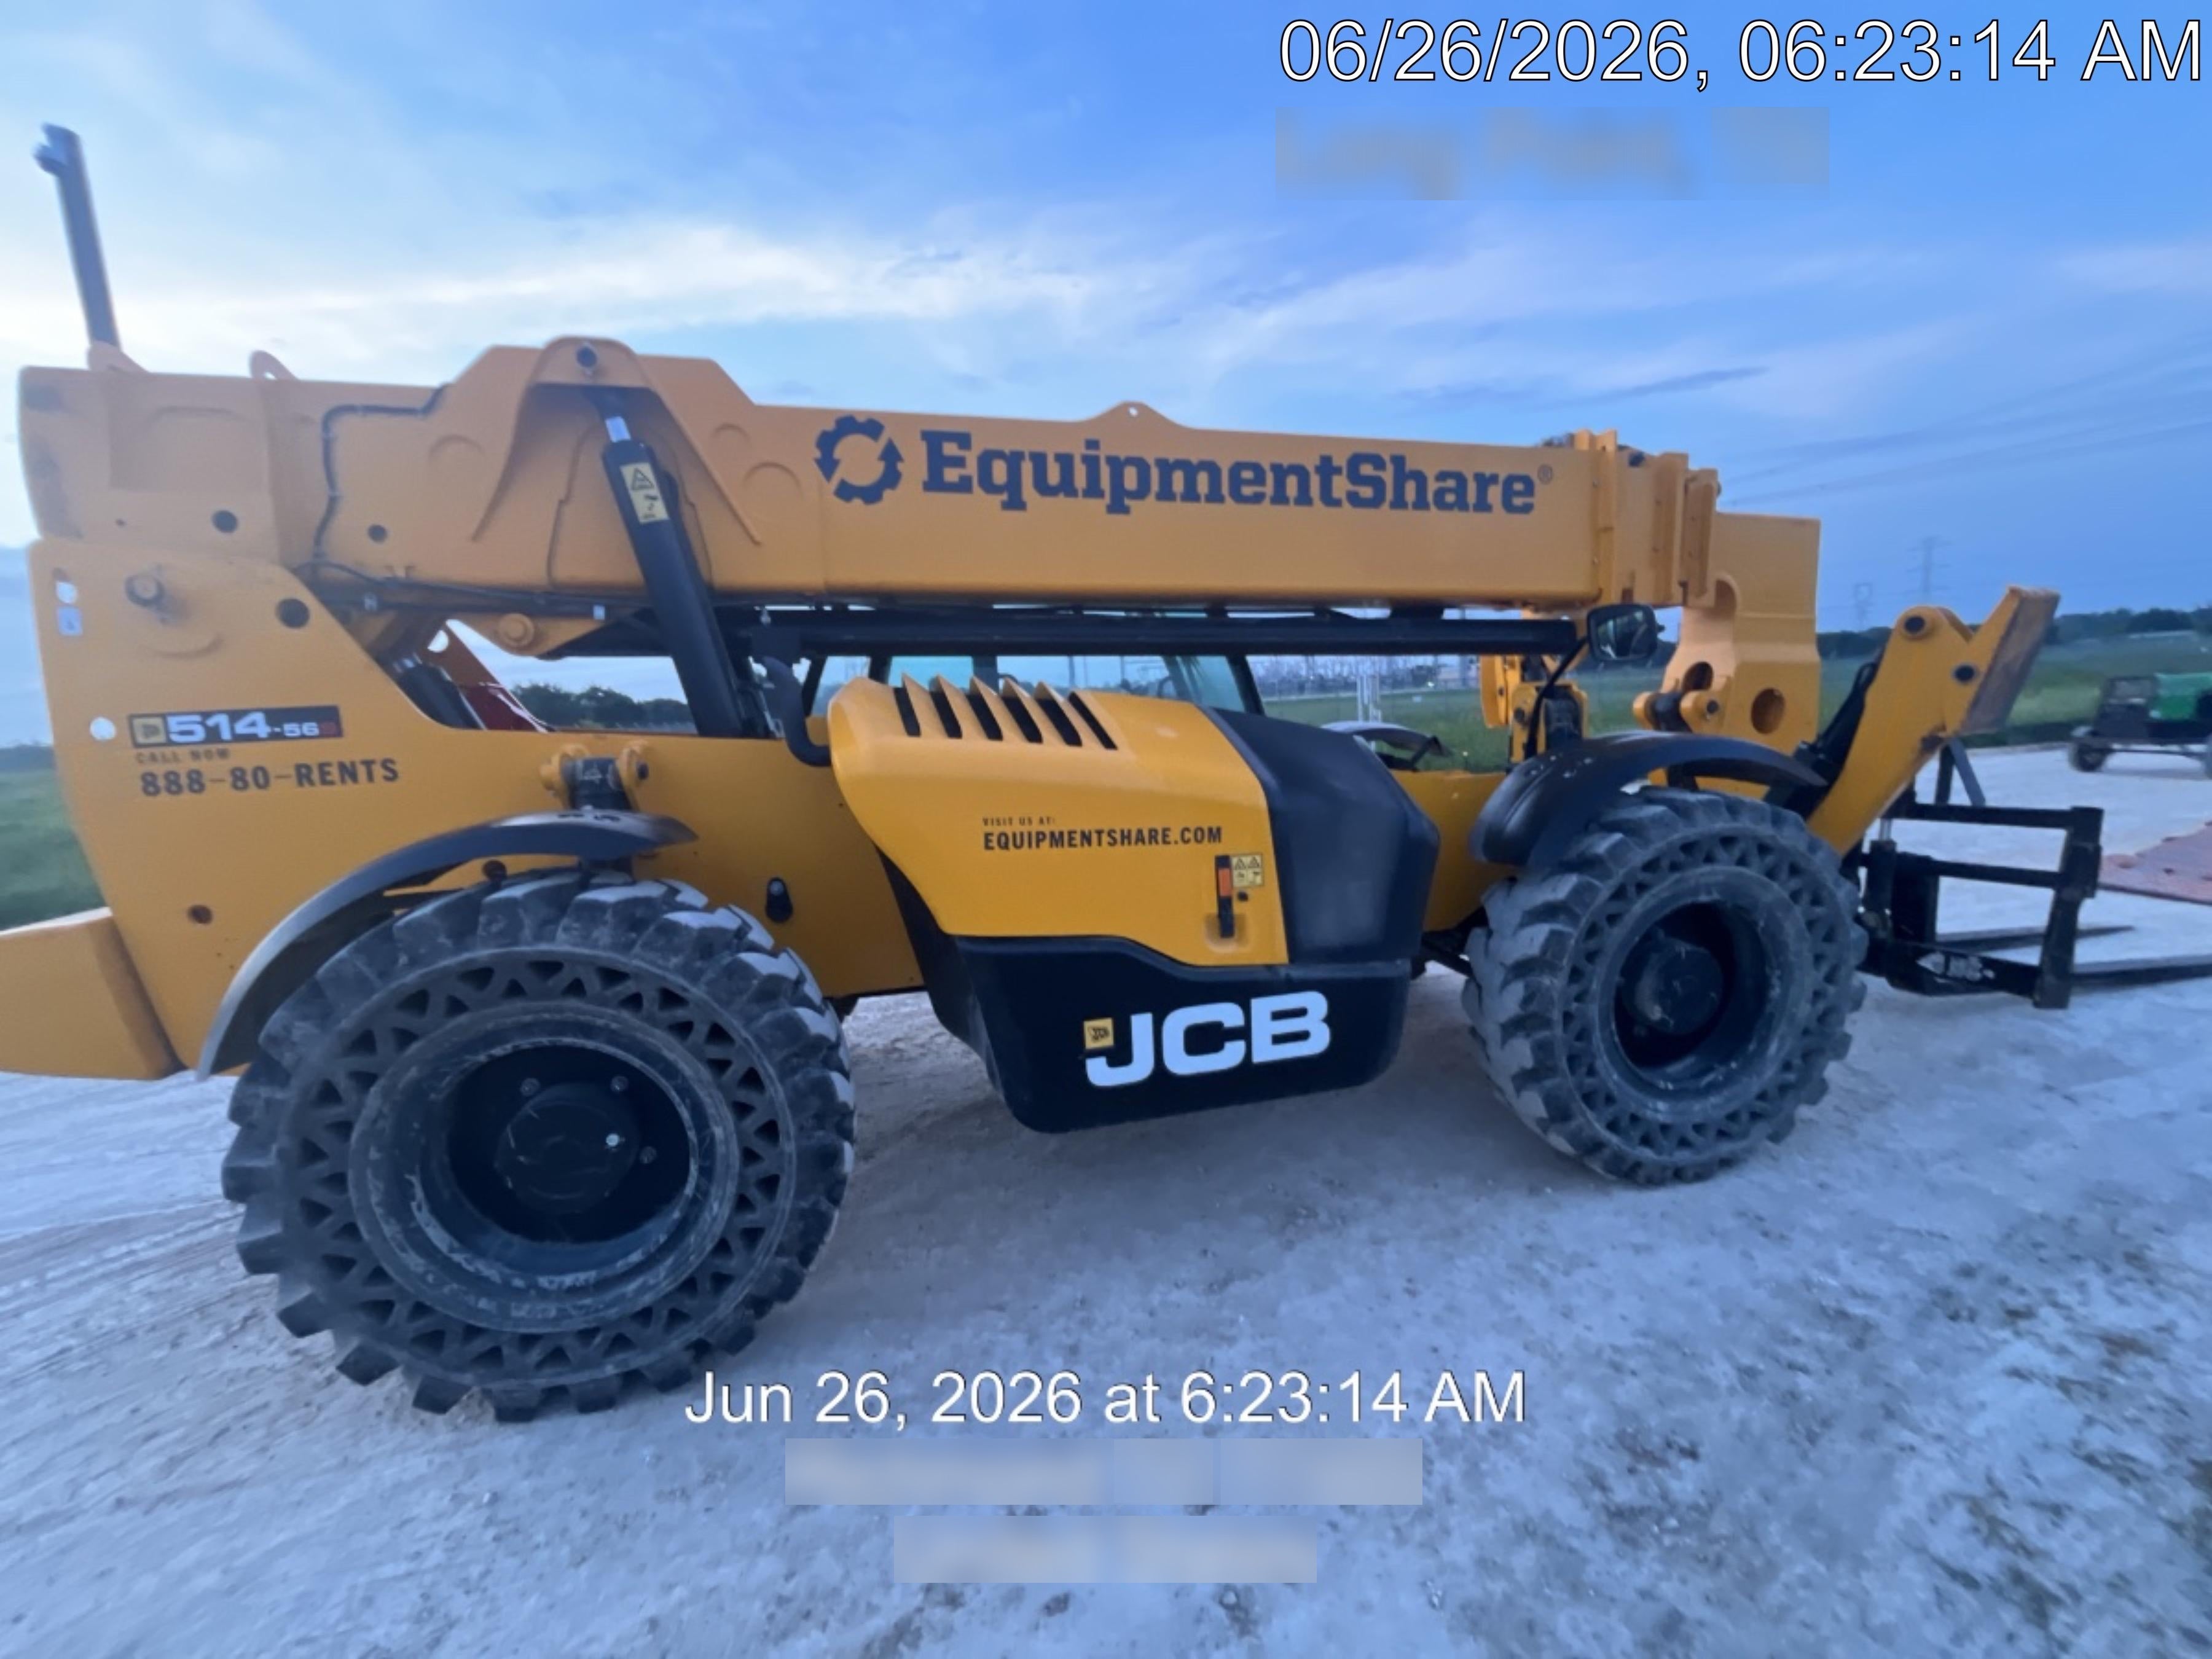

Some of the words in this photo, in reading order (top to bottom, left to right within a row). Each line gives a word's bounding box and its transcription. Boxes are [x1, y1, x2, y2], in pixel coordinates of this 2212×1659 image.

[136, 751, 181, 764] CALL
[190, 748, 230, 761] NOW
[140, 758, 399, 797] 888-80-RENTS
[982, 817, 1013, 826] VISIT
[1019, 817, 1033, 826] US
[983, 826, 1222, 851] EQUIPMENTSHARE.COM
[1085, 991, 1331, 1087] JCB
